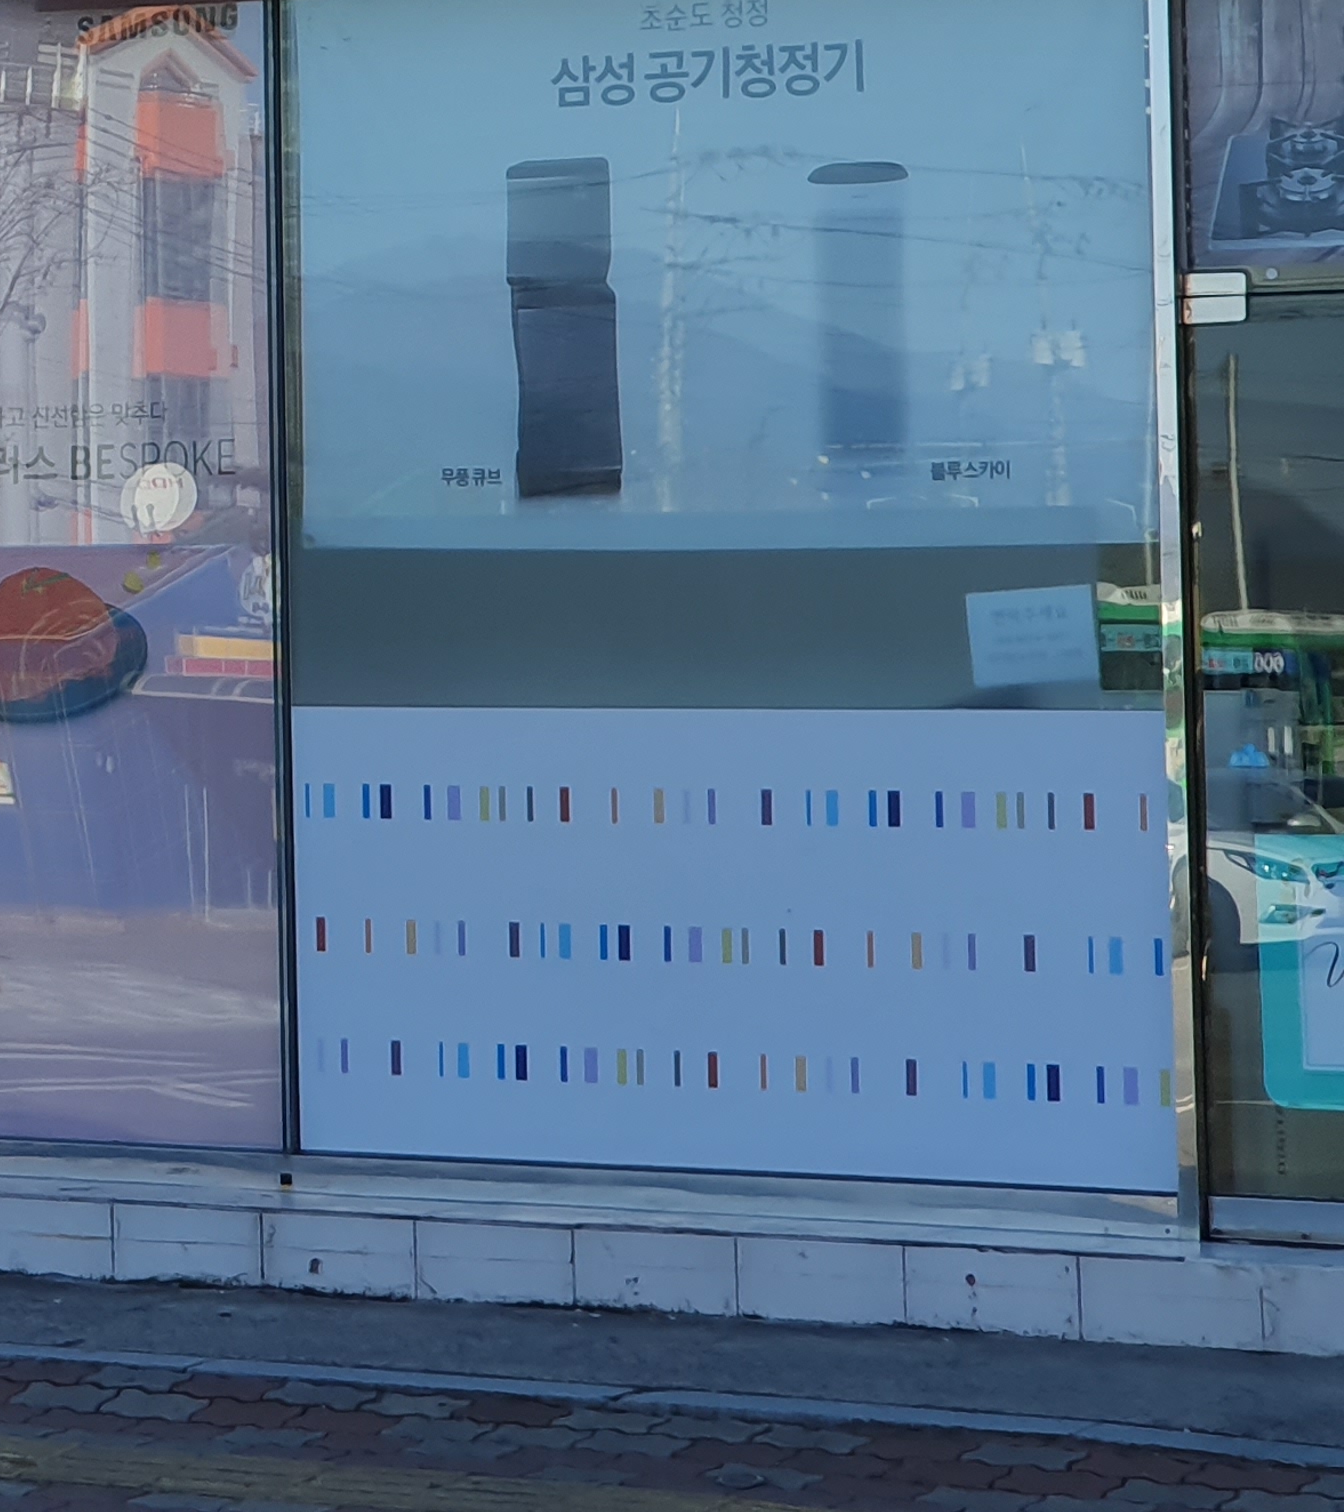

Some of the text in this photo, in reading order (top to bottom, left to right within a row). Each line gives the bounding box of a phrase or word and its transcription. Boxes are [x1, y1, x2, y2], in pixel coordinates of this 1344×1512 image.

[77, 2, 238, 44] SAMSUNG
[640, 1, 713, 32] 초순도
[550, 39, 865, 107] 삼성 공기청정기
[70, 438, 237, 481] BESPOKE
